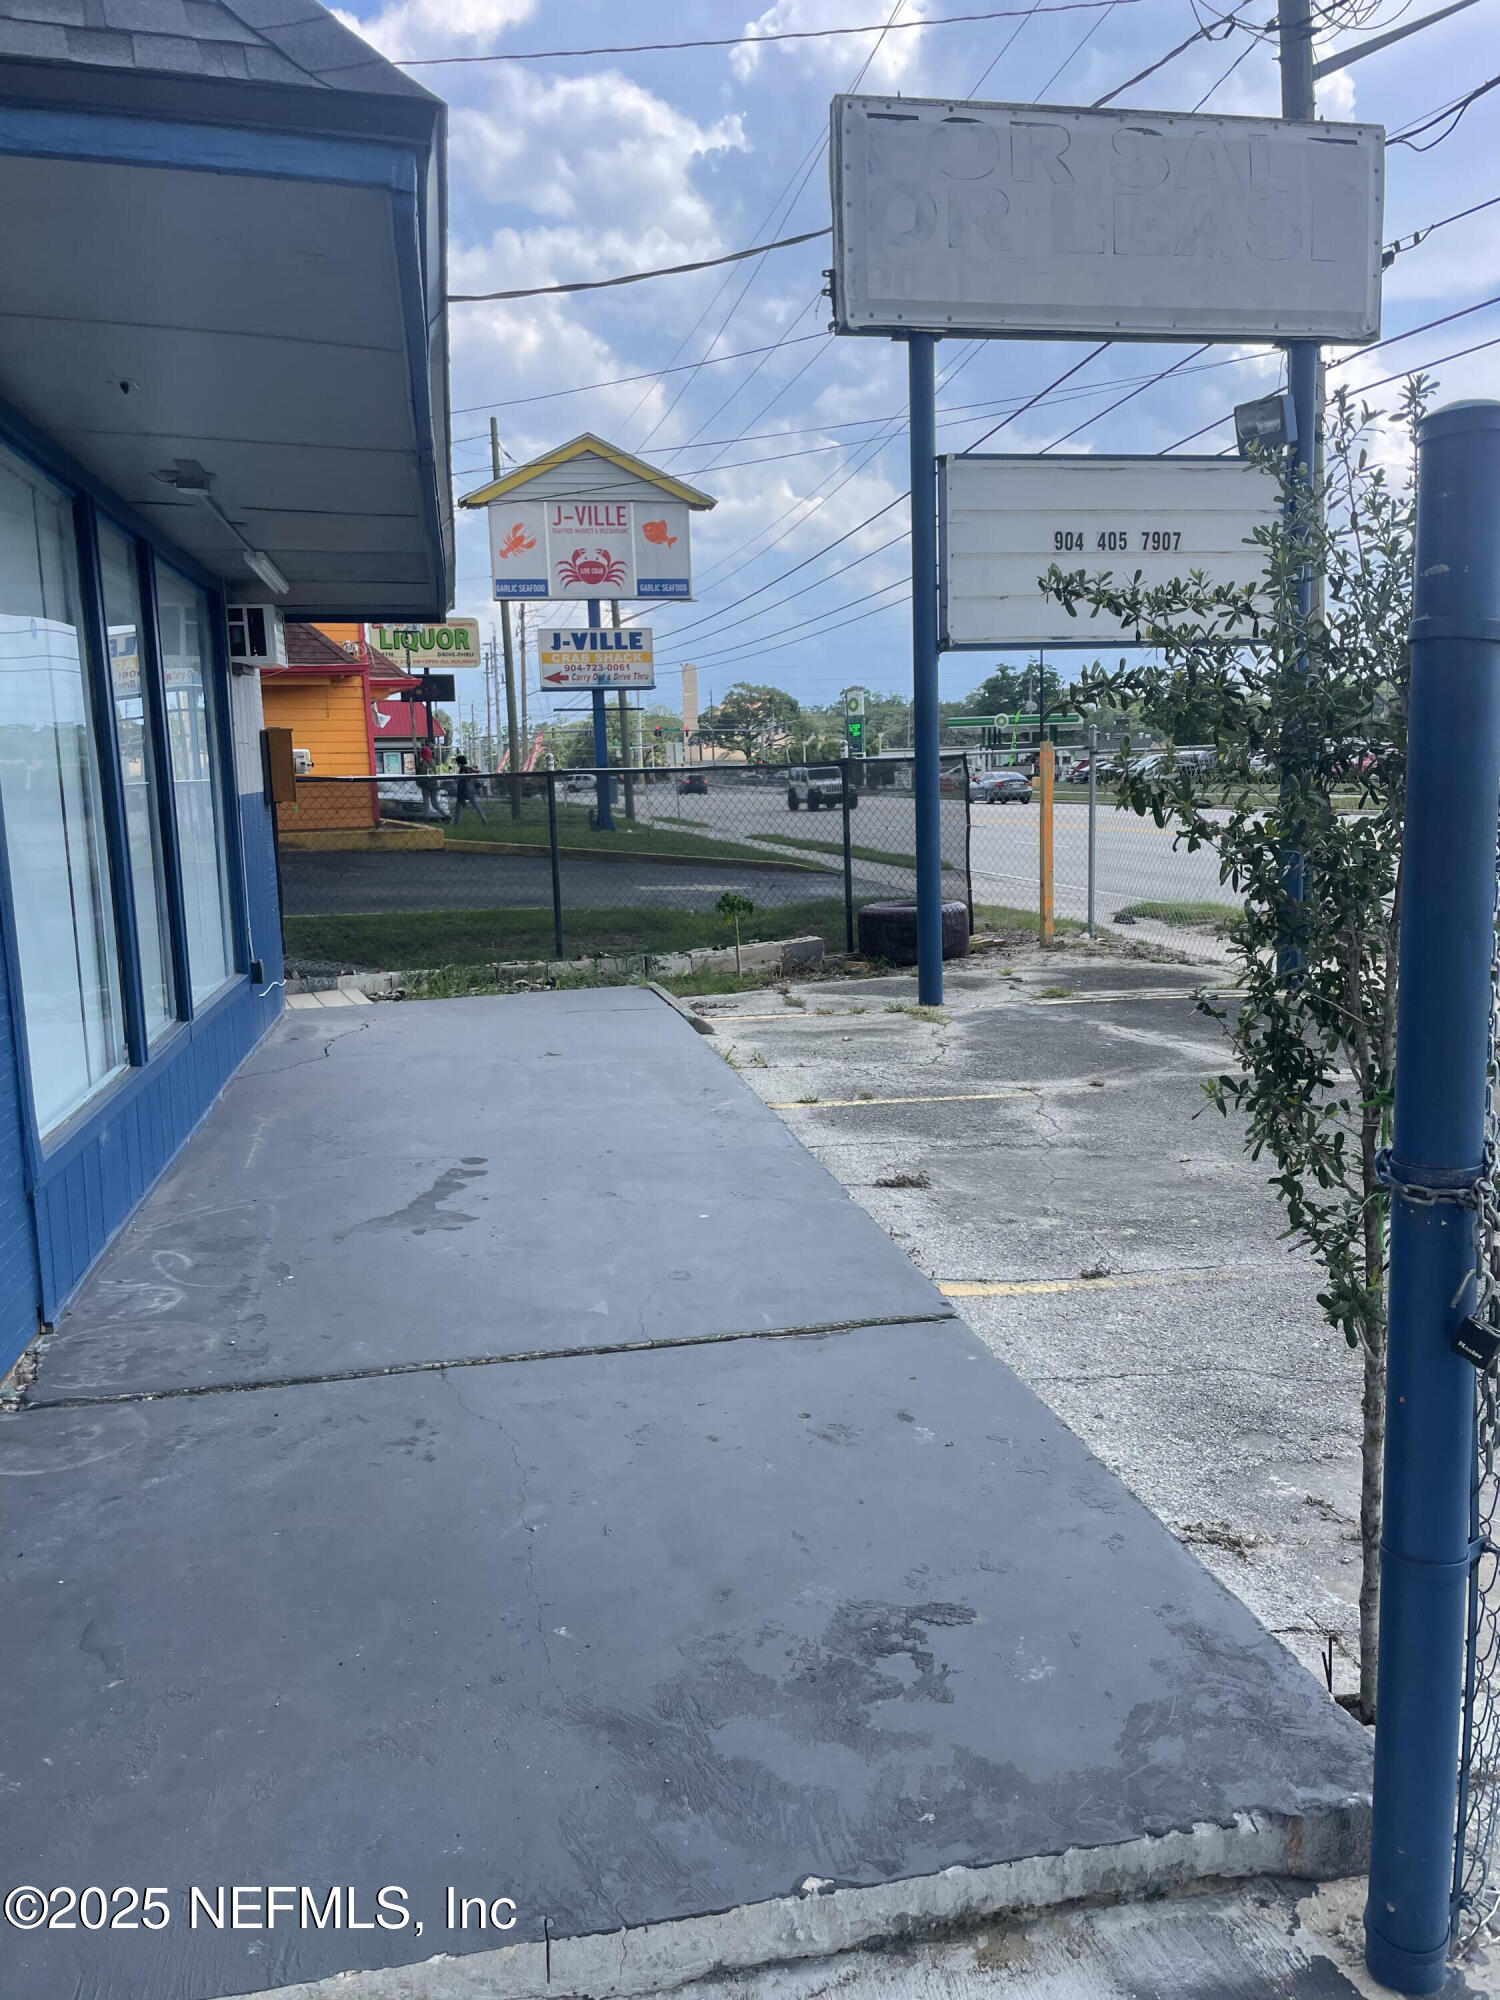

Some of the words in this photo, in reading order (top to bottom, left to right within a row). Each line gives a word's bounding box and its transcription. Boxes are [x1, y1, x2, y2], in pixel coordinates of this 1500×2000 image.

[552, 504, 627, 526] J-VILLE
[1054, 531, 1084, 550] 904
[1097, 531, 1127, 550] 405
[1142, 531, 1181, 550] 7907
[580, 567, 590, 575] LIVE
[496, 584, 517, 593] GARLIC
[518, 584, 546, 593] SEAFOOD
[639, 584, 660, 592] GARLIC
[661, 583, 687, 592] SEAFOOD
[551, 632, 642, 650] J-VILLE
[551, 653, 589, 663] CRAB
[594, 652, 642, 662] SHACK
[571, 673, 591, 682] Carry
[613, 673, 631, 681] Drive
[633, 672, 649, 680] Thru
[1457, 1340, 1483, 1360] Master
